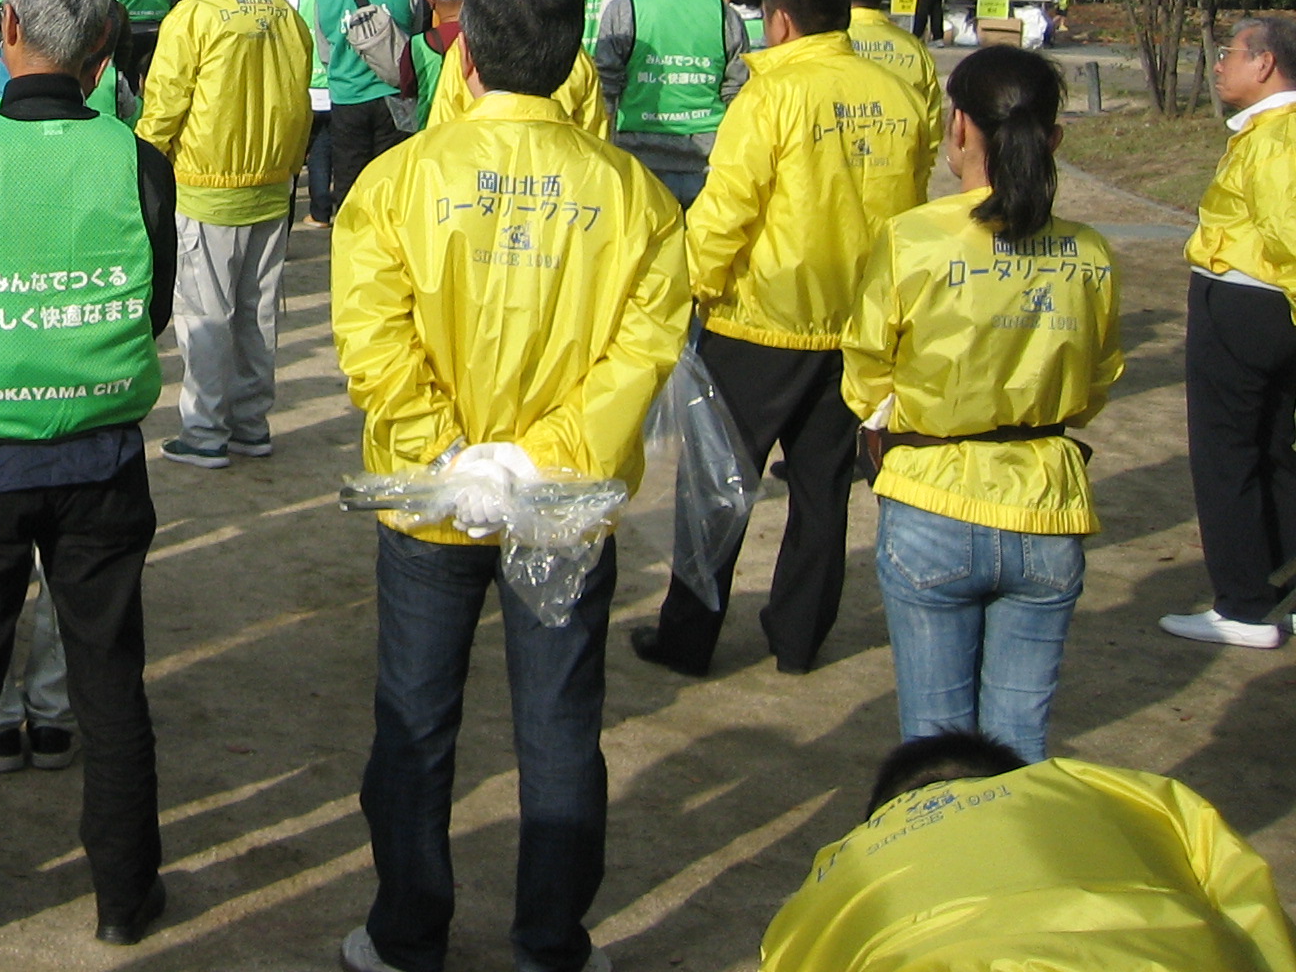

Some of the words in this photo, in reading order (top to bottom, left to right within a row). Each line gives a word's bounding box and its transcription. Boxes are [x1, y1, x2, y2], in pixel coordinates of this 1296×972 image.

[477, 170, 561, 197] 岡山北西
[437, 195, 601, 232] ロータリークラブ
[948, 259, 1111, 293] ロータリークラブ
[93, 377, 133, 396] CITY
